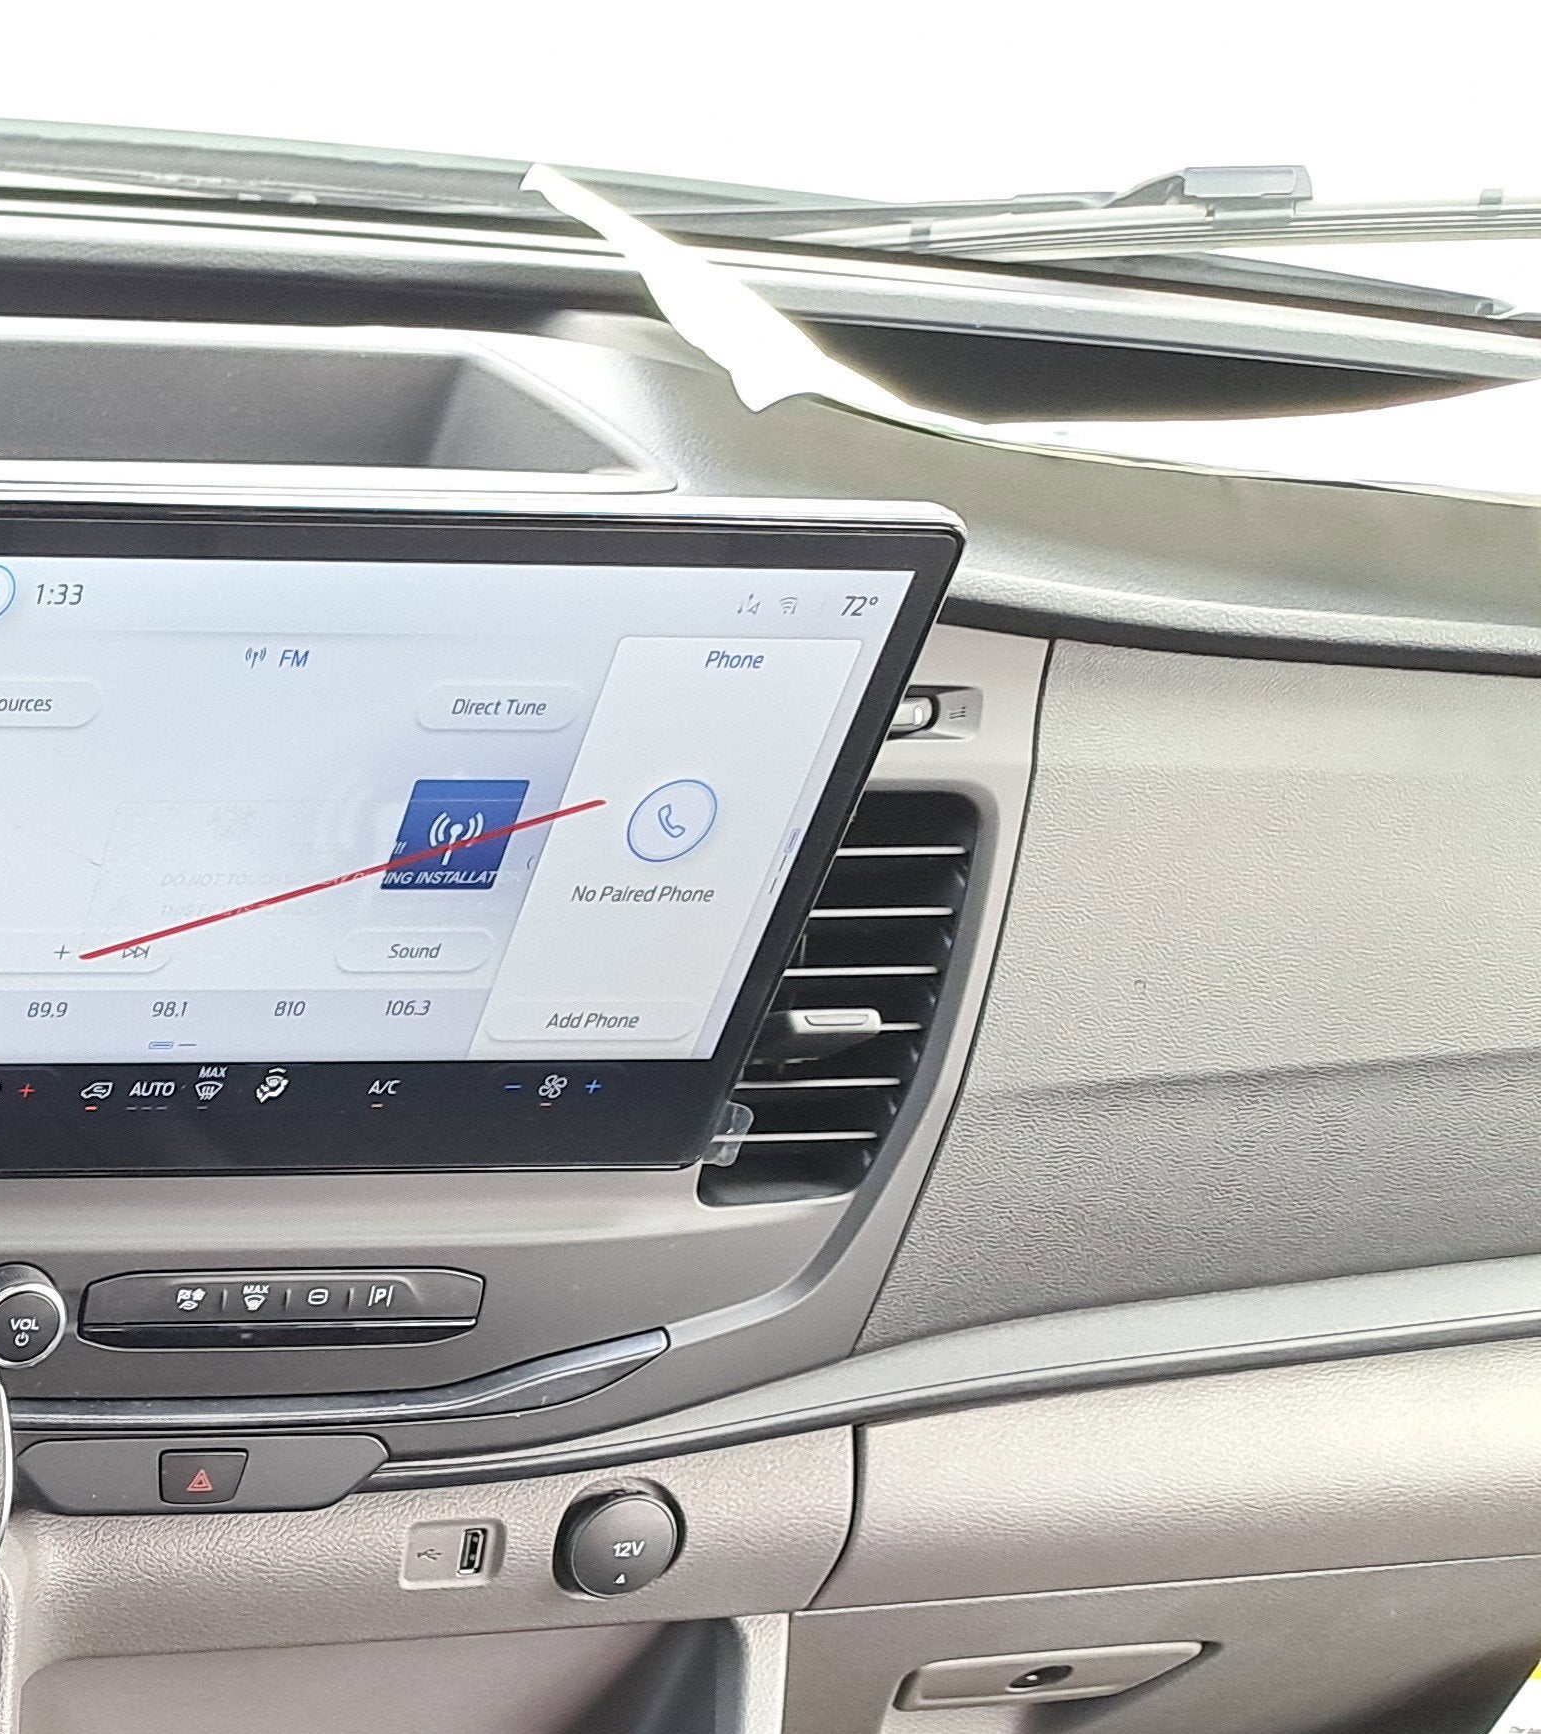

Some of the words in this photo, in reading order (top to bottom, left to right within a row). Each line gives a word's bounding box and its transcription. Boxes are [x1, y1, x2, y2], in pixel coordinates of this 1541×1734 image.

[34, 582, 85, 607] 1:33
[840, 595, 879, 617] 72°
[278, 649, 310, 668] FM
[704, 650, 764, 669] Phone
[451, 698, 501, 716] Direct
[505, 698, 547, 716] Tune
[571, 885, 595, 903] No
[600, 884, 655, 903] Paired
[657, 884, 715, 903] Phone
[388, 942, 442, 960] Sound
[27, 1001, 68, 1019] 89.9
[150, 1000, 188, 1018] 98.1
[273, 1000, 306, 1018] 810
[384, 999, 431, 1017] 106.3
[546, 1011, 579, 1029] Add
[581, 1011, 640, 1030] Phone
[198, 1066, 228, 1079] MAX
[128, 1080, 176, 1099] AUTO
[367, 1078, 400, 1098] A/C
[242, 1285, 270, 1295] MAX
[9, 1316, 40, 1332] VOL
[612, 1541, 645, 1558] 12V
